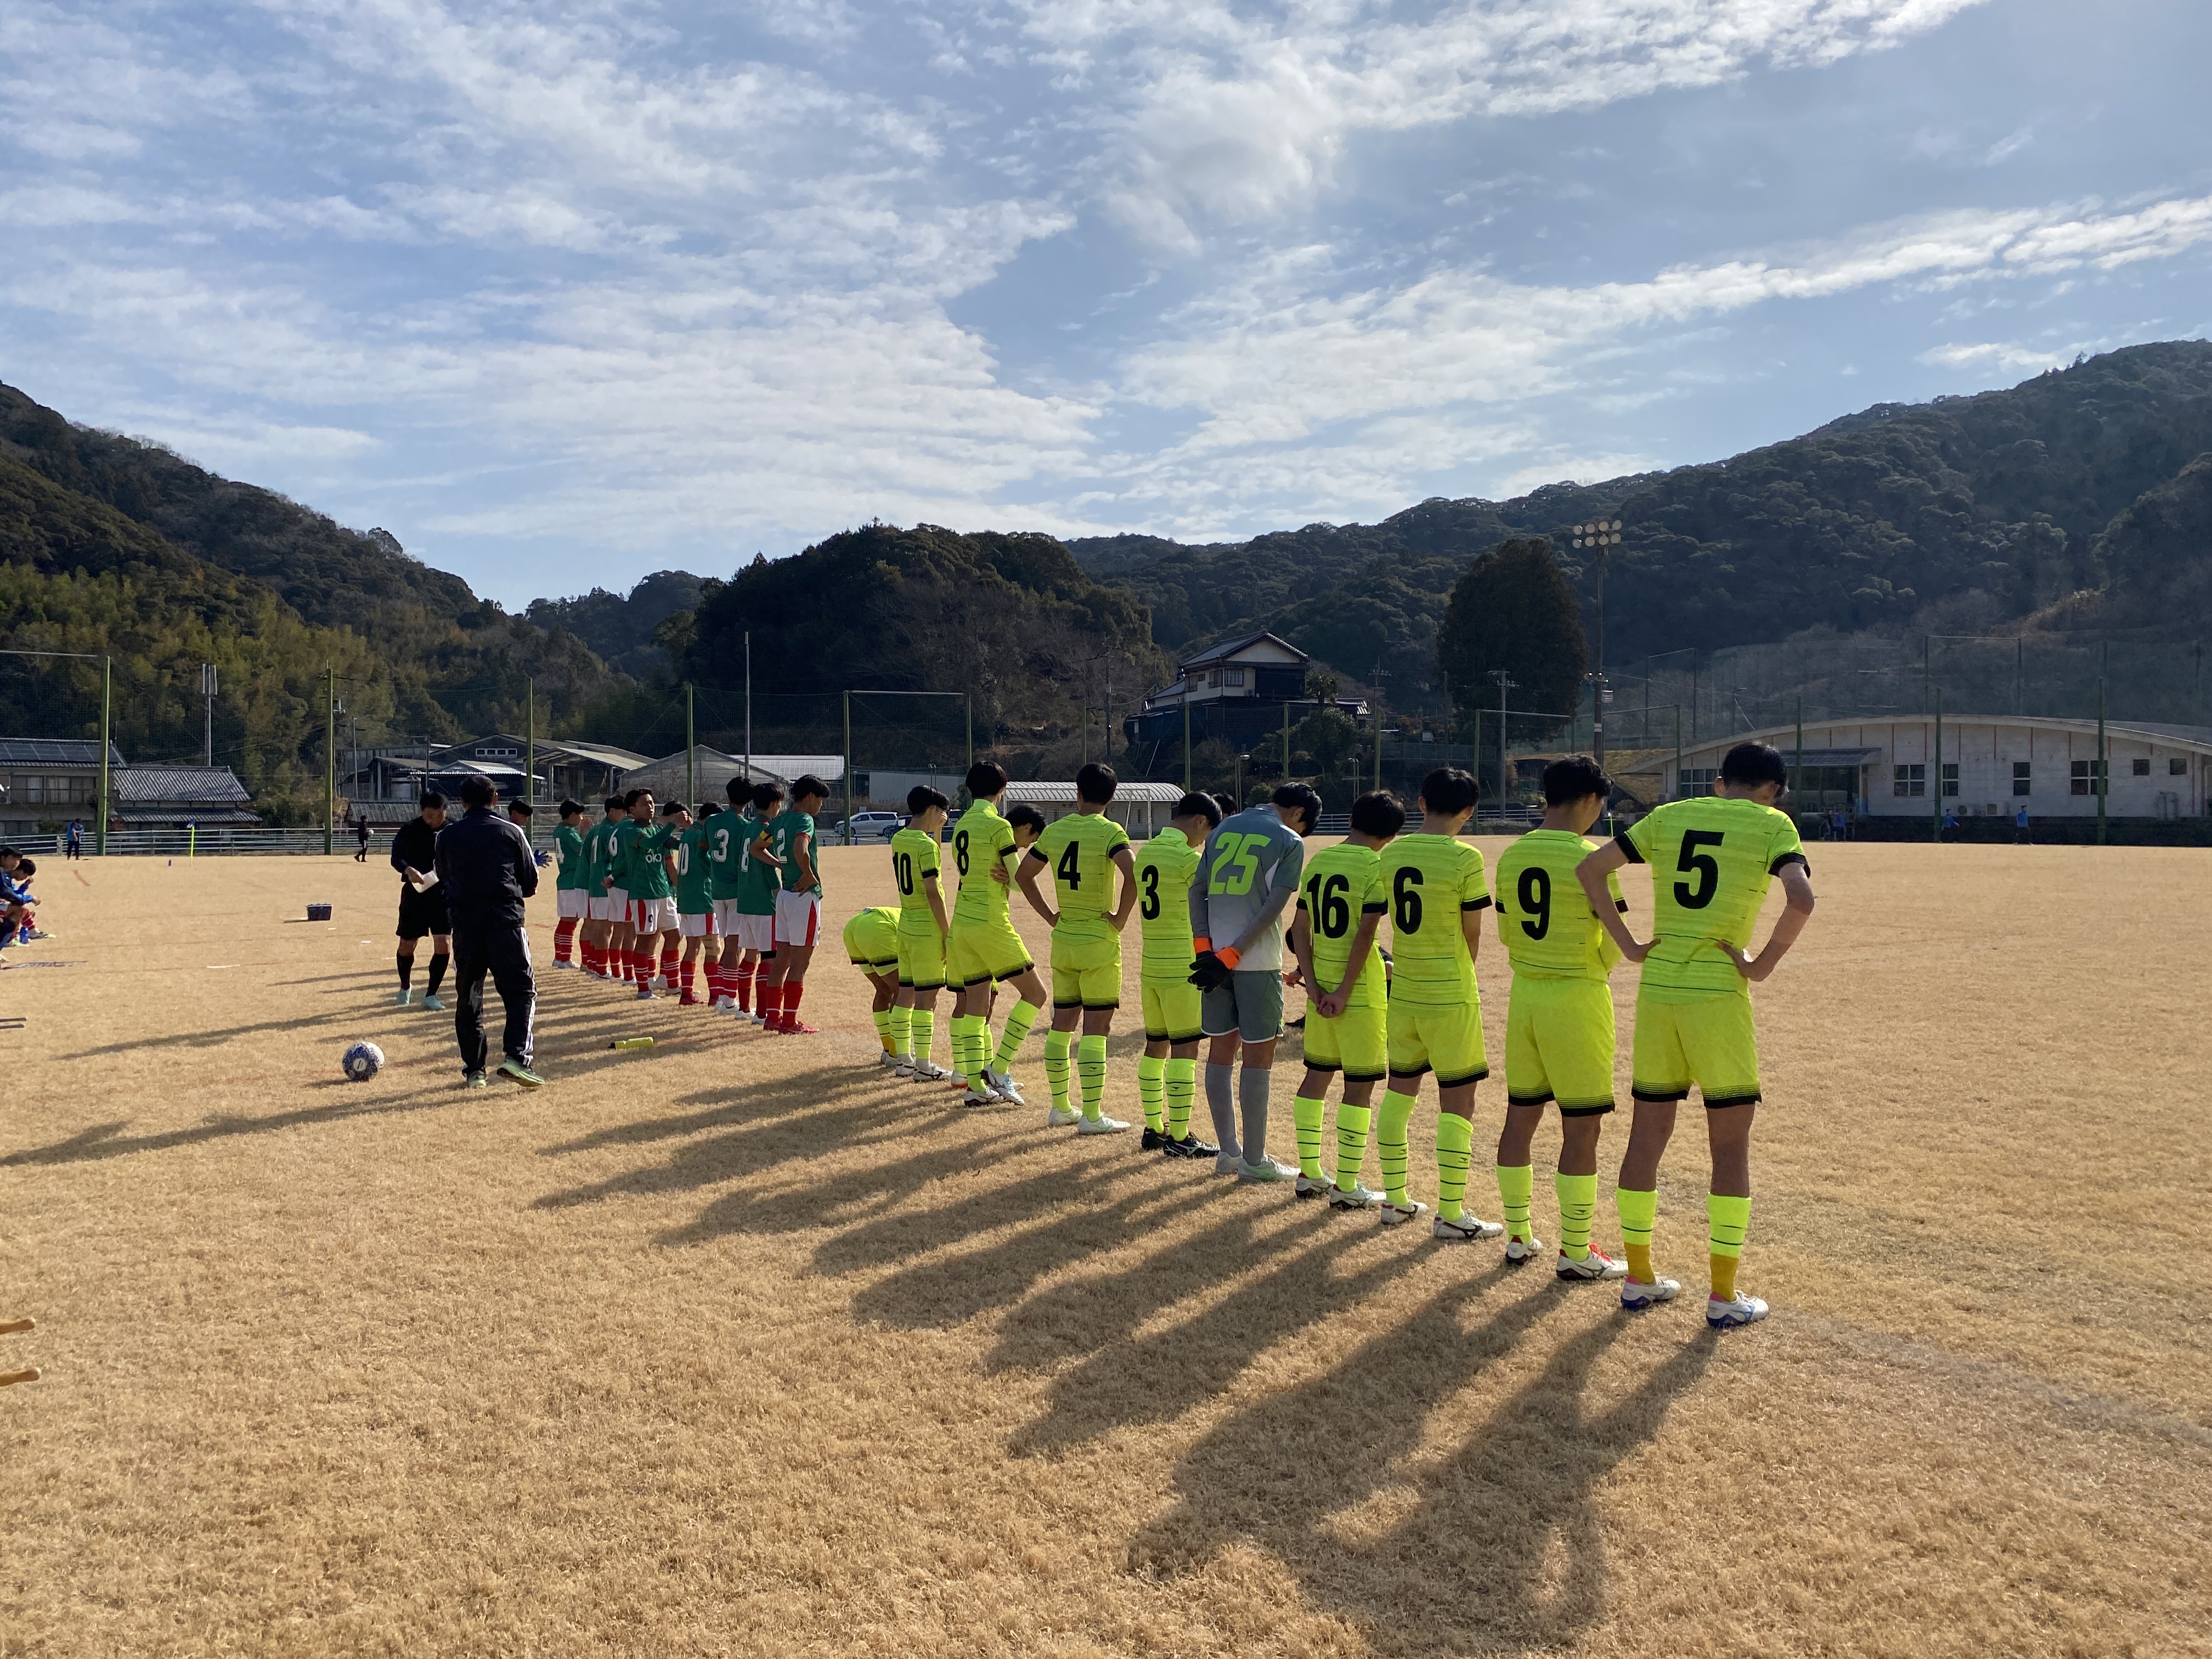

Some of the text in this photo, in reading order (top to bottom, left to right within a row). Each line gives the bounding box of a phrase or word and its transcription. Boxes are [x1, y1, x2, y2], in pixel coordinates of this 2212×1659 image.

[556, 838, 565, 864] 4
[608, 828, 619, 857] 6
[677, 843, 689, 876] 10
[712, 828, 729, 863] 3
[741, 837, 751, 872] 8
[776, 828, 788, 864] 2
[955, 830, 970, 877] 8
[1057, 840, 1082, 890] 4
[1208, 832, 1272, 895] 25
[893, 851, 913, 896] 10
[1141, 865, 1160, 921] 3
[1673, 829, 1725, 910] 5
[1306, 873, 1350, 939] 16
[1393, 866, 1424, 935] 6
[1517, 866, 1551, 941] 9
